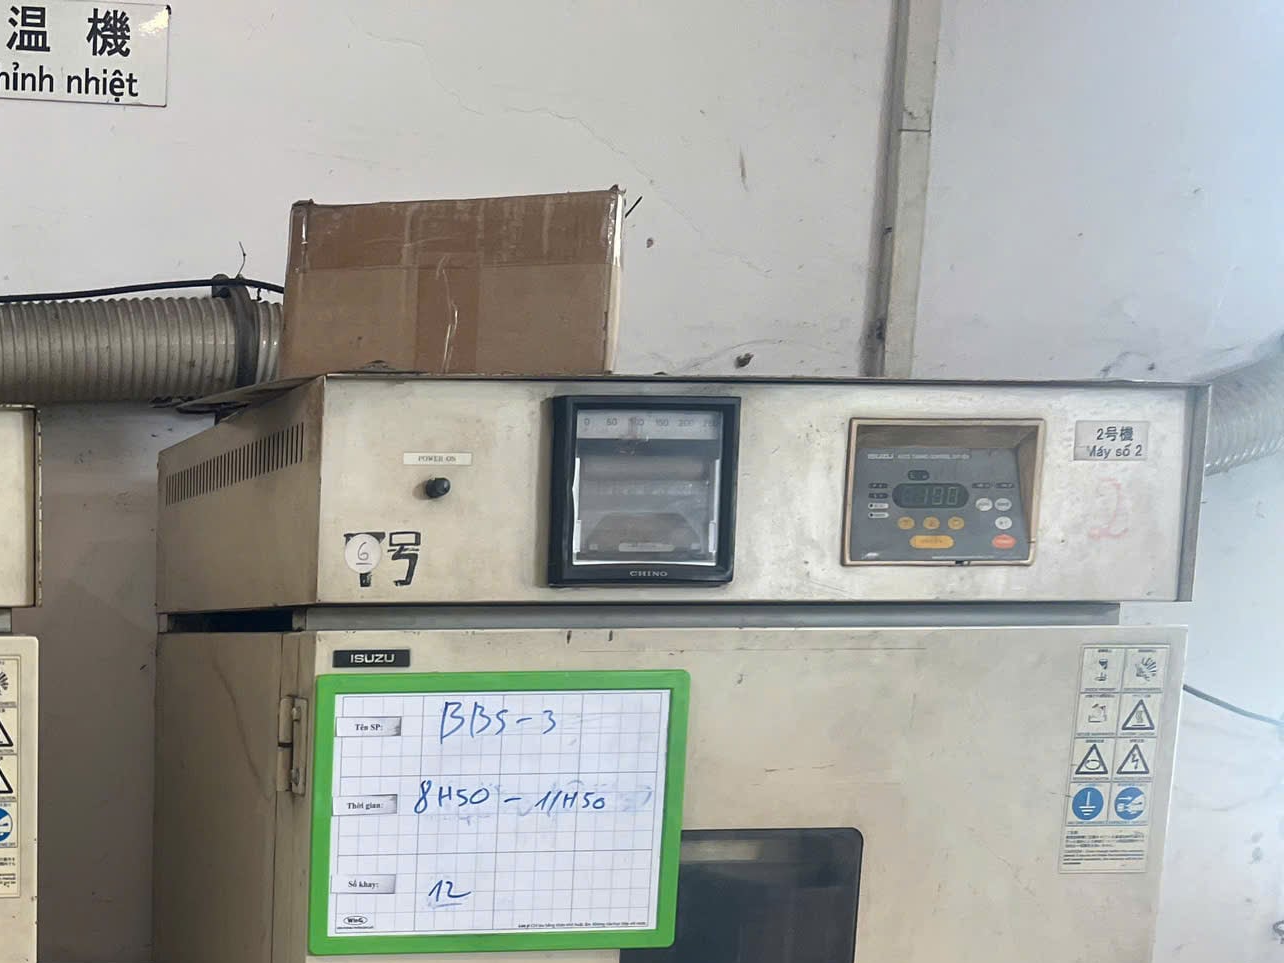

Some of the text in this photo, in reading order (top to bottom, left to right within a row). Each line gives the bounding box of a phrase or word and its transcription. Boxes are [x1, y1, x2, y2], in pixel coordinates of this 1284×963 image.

[67, 67, 139, 102] nhiệt
[1115, 443, 1132, 457] số
[1134, 445, 1143, 456] 2
[350, 653, 395, 663] ISUZU
[428, 879, 472, 902] 12
